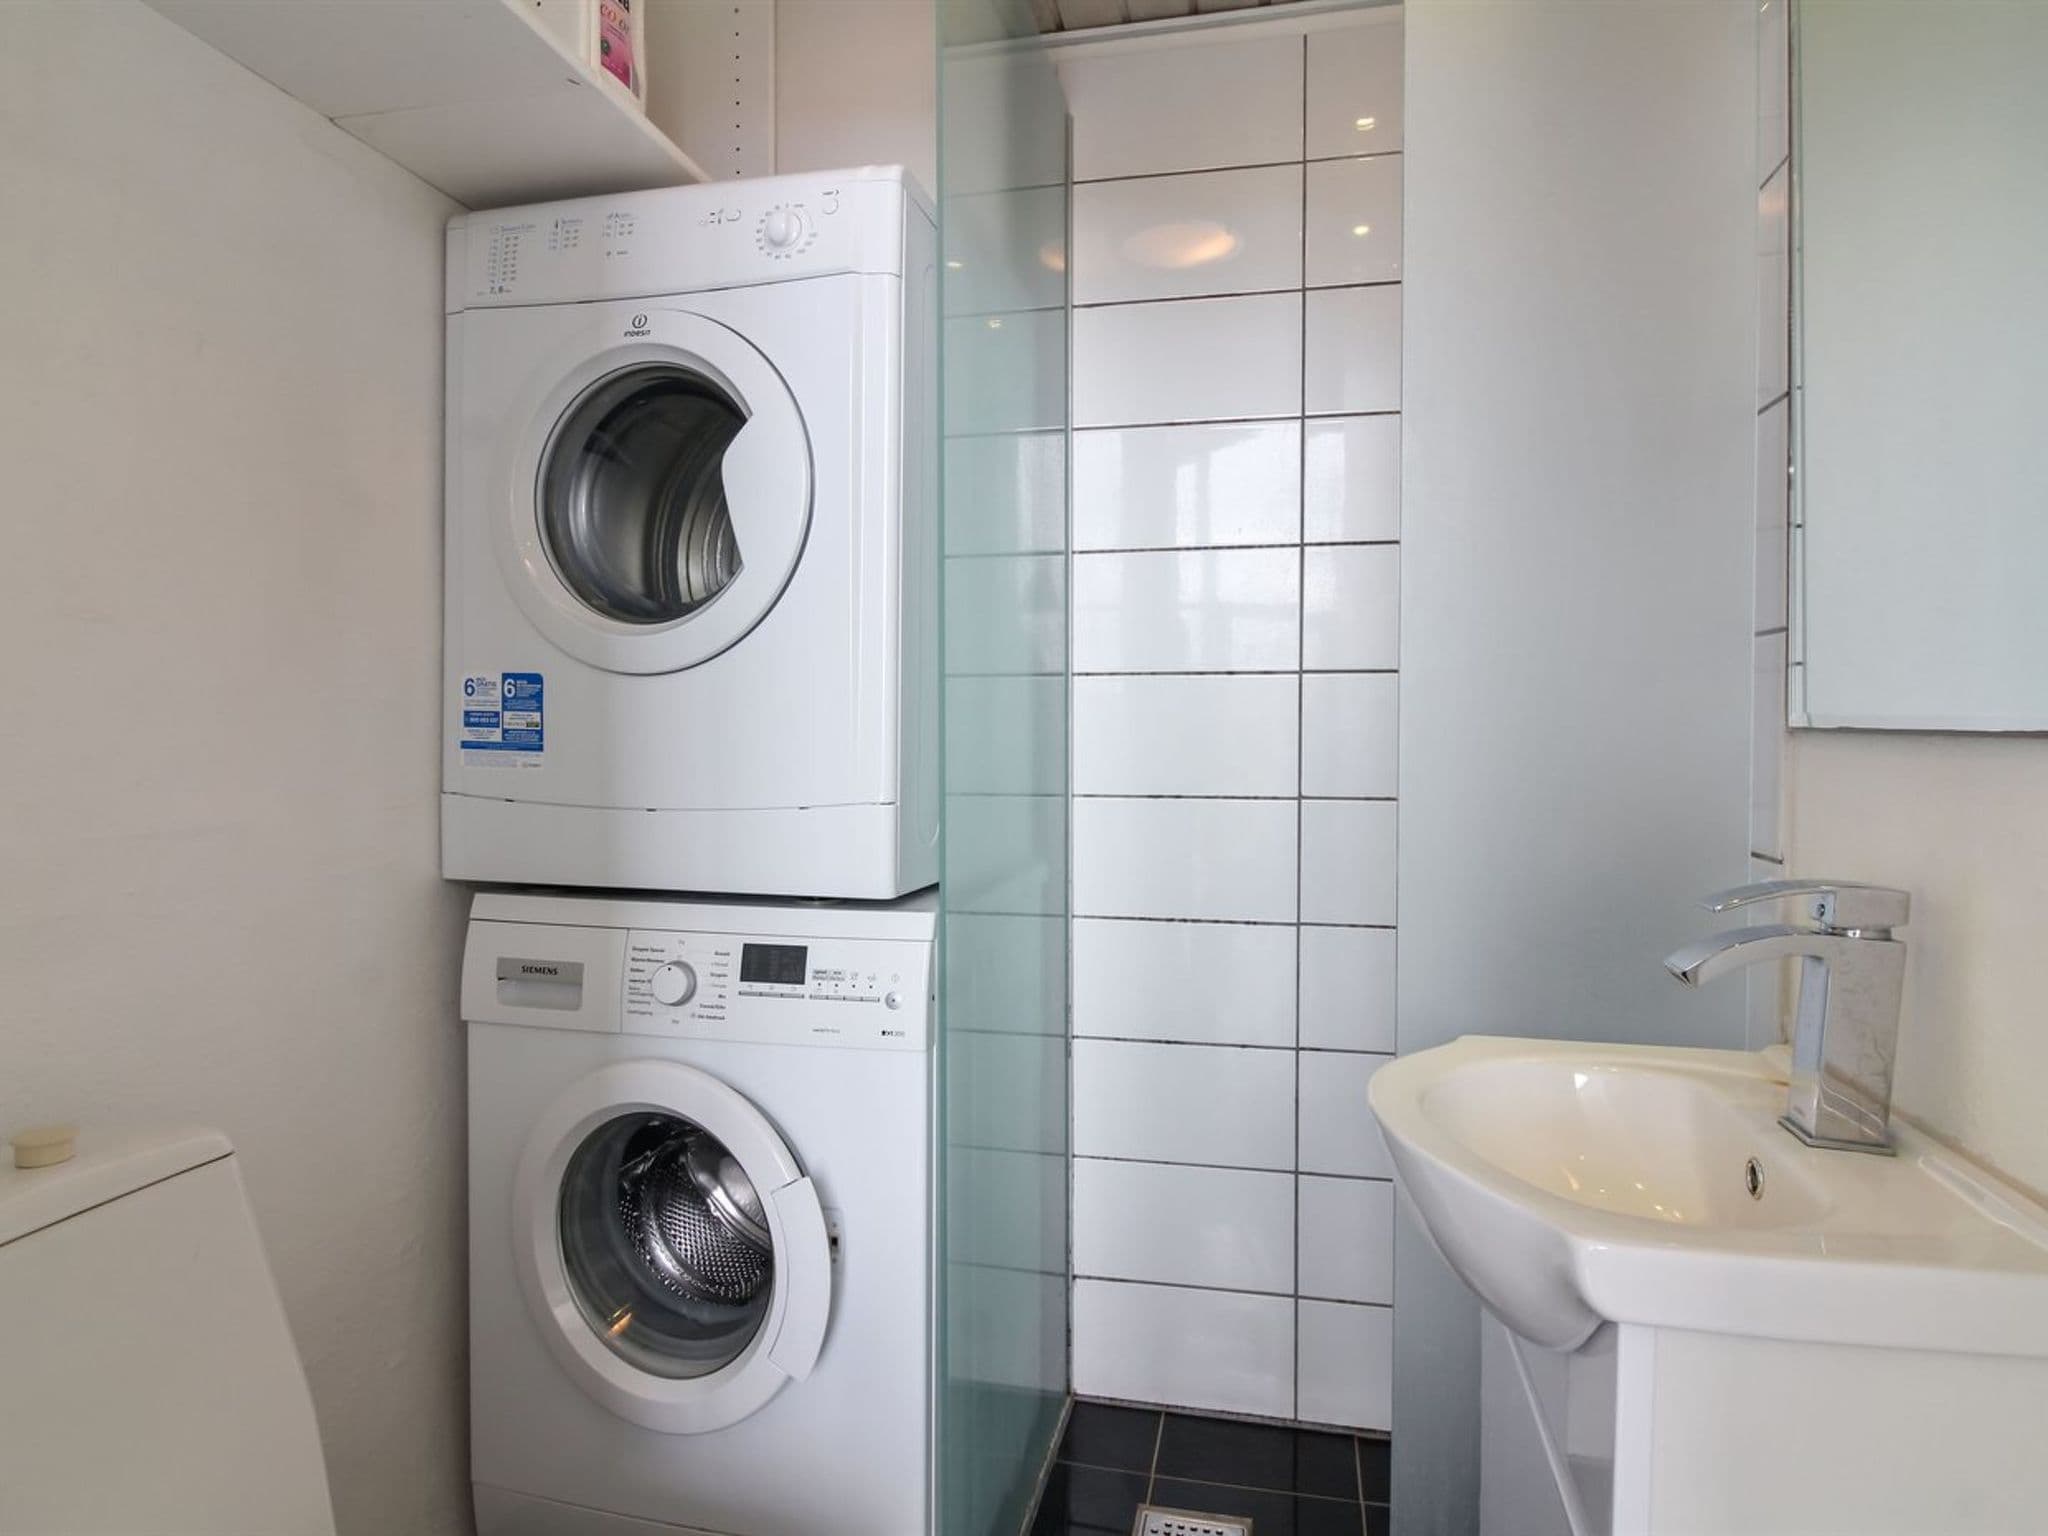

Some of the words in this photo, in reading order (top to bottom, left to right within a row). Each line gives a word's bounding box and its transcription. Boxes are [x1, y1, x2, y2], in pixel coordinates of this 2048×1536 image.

[464, 678, 475, 697] 6
[503, 679, 516, 698] 6
[520, 964, 559, 976] SIEMENS
